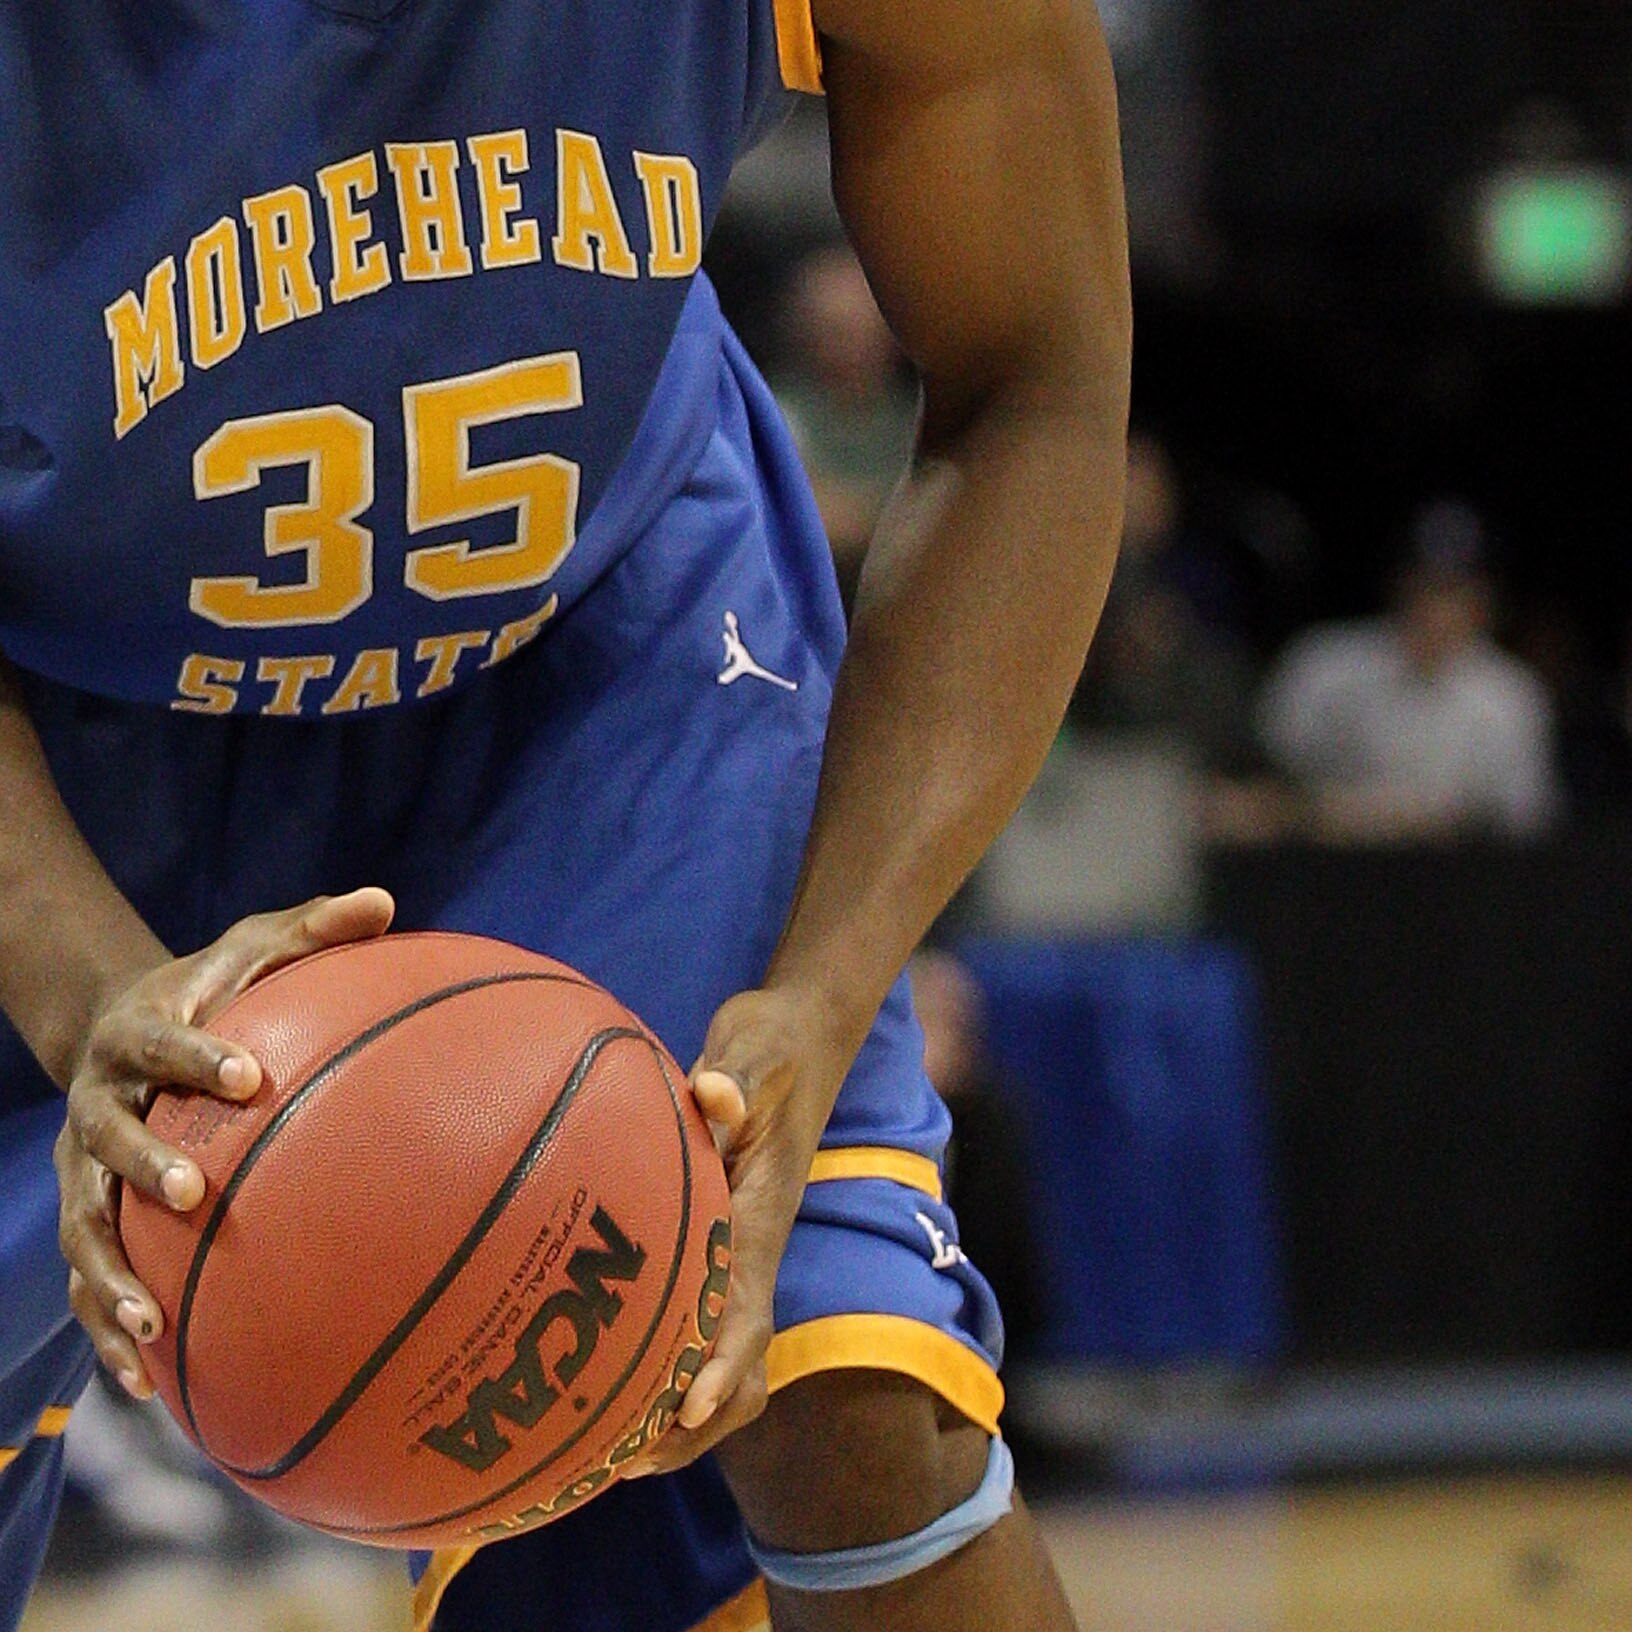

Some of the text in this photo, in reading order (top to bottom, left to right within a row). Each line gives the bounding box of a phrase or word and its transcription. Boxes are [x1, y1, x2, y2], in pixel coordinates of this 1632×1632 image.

[104, 128, 703, 441] MOREHEAD
[188, 350, 584, 630] 35
[419, 1204, 647, 1473] NCAA
